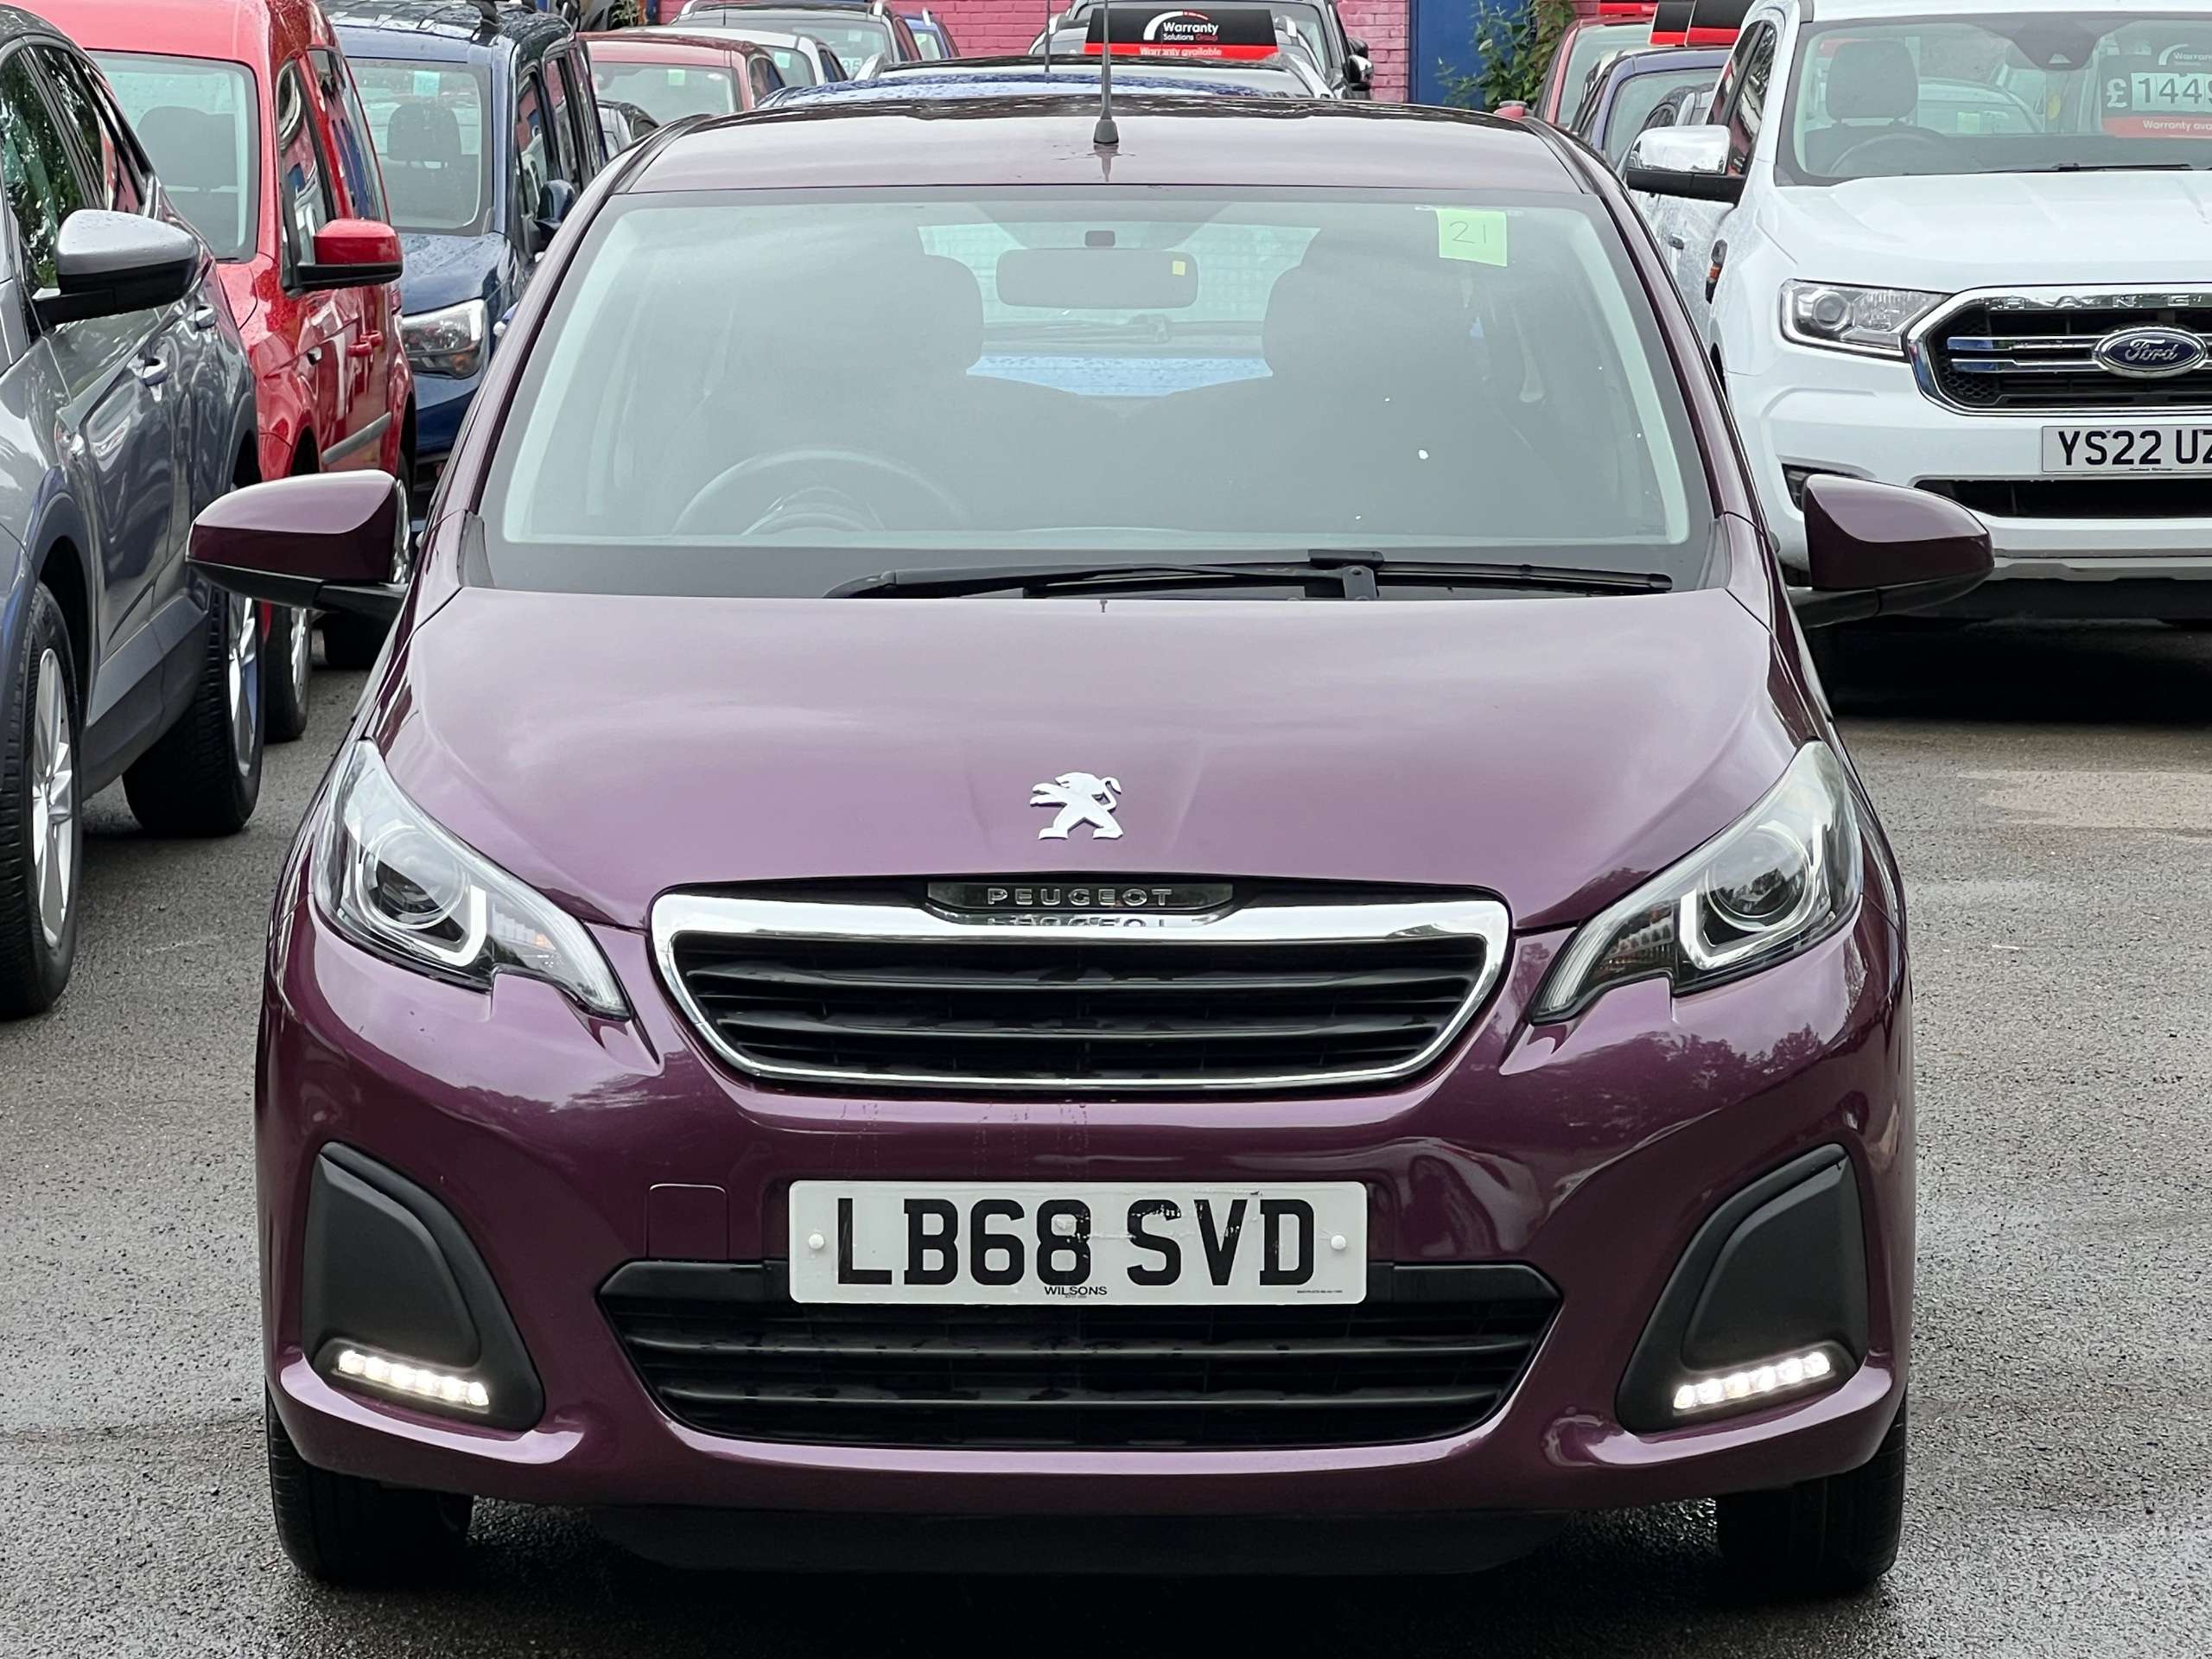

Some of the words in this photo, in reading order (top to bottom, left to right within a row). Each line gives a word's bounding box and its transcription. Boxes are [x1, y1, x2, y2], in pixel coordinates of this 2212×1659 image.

[1163, 22, 1218, 35] Warranty
[2143, 120, 2192, 132] Warranty
[1450, 220, 1486, 244] 21
[2125, 339, 2178, 361] Ford
[2058, 430, 2161, 466] YS22
[987, 887, 1173, 906] PEUGEOT
[837, 1198, 1091, 1286] LB68
[1127, 1198, 1315, 1286] SVD
[1044, 1286, 1108, 1296] WILSONS
